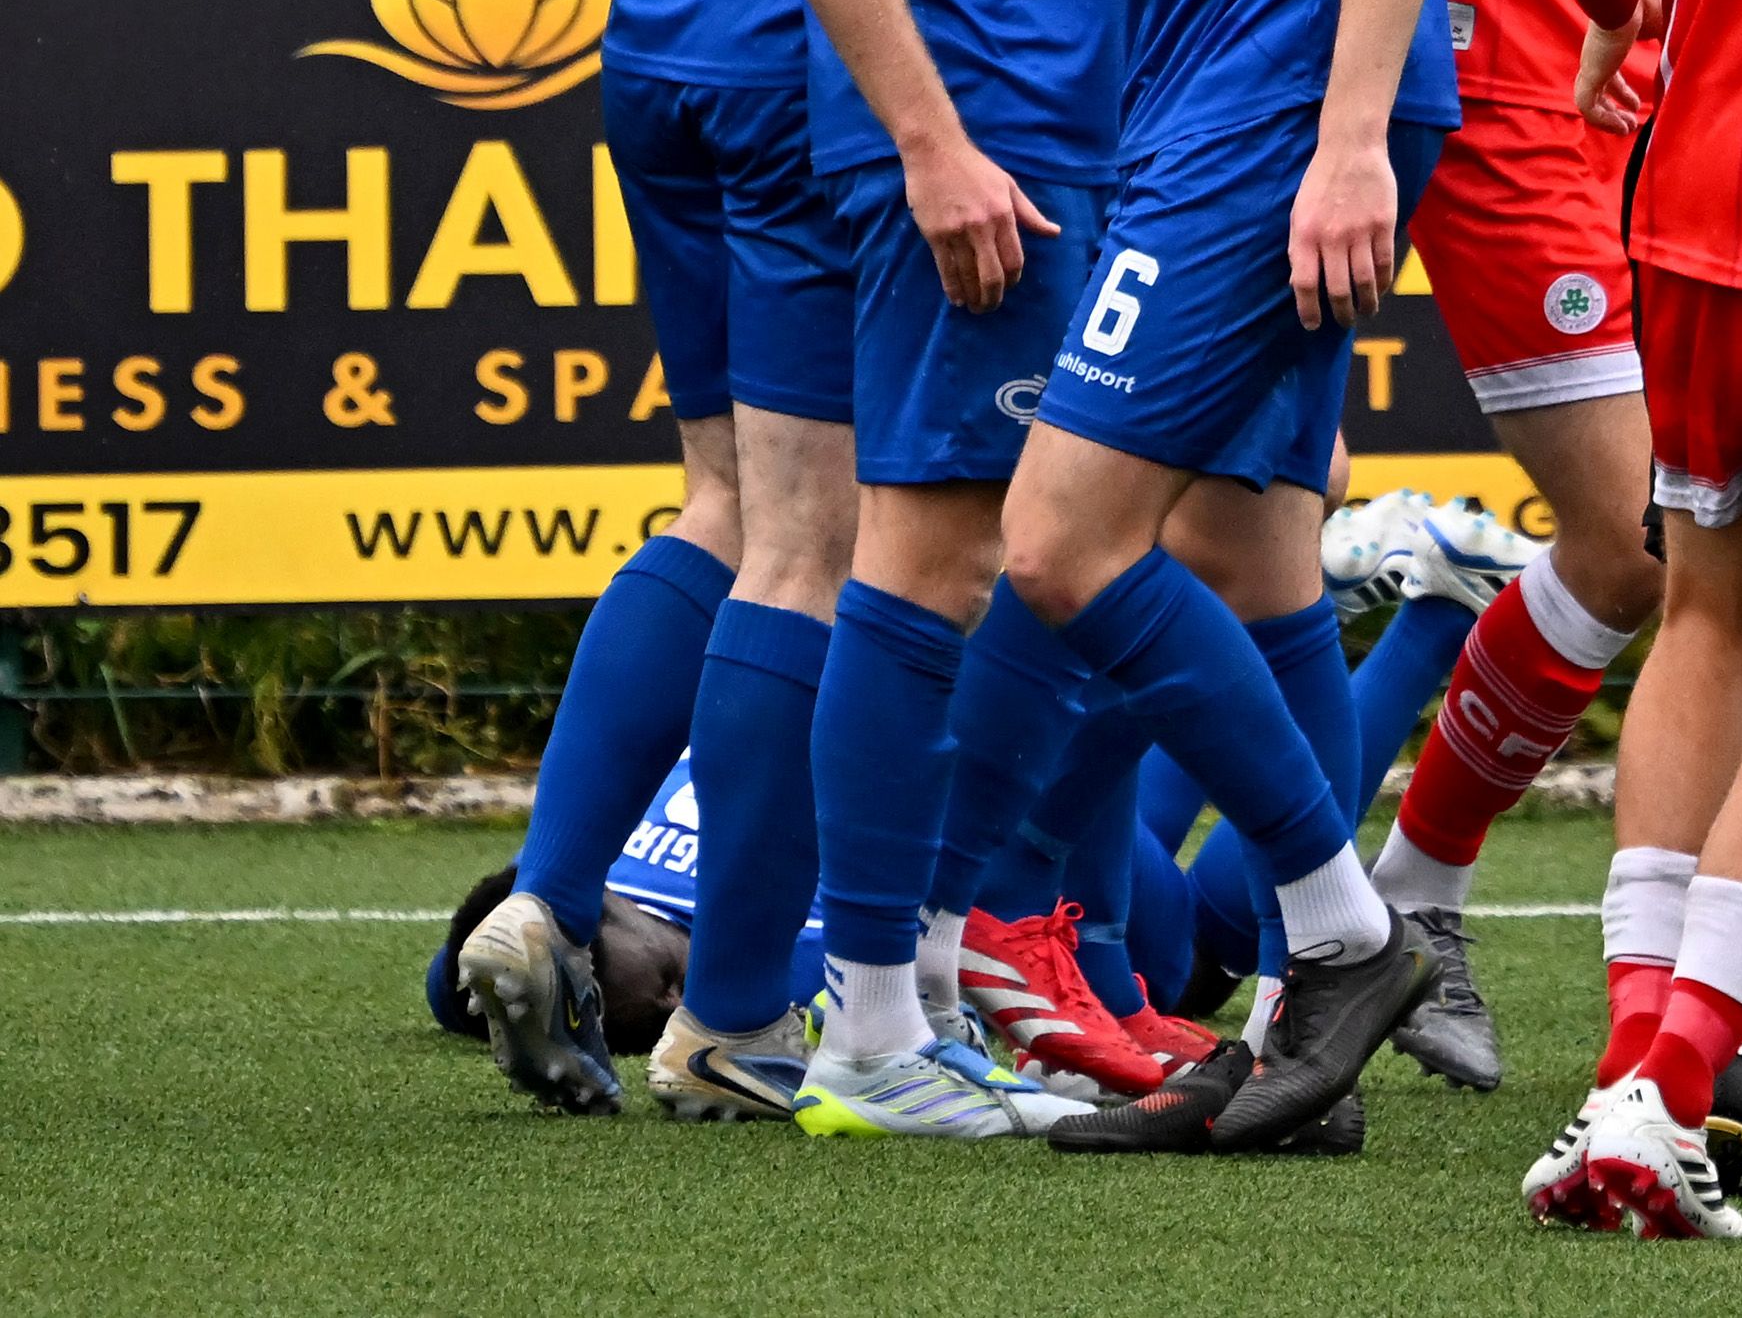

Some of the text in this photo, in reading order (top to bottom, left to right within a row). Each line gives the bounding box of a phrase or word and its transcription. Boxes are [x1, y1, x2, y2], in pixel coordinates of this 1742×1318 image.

[1082, 248, 1160, 357] 6
[0, 356, 245, 432] ESS
[323, 352, 397, 428] &
[1057, 352, 1137, 394] uhlsport
[0, 501, 204, 579] 517
